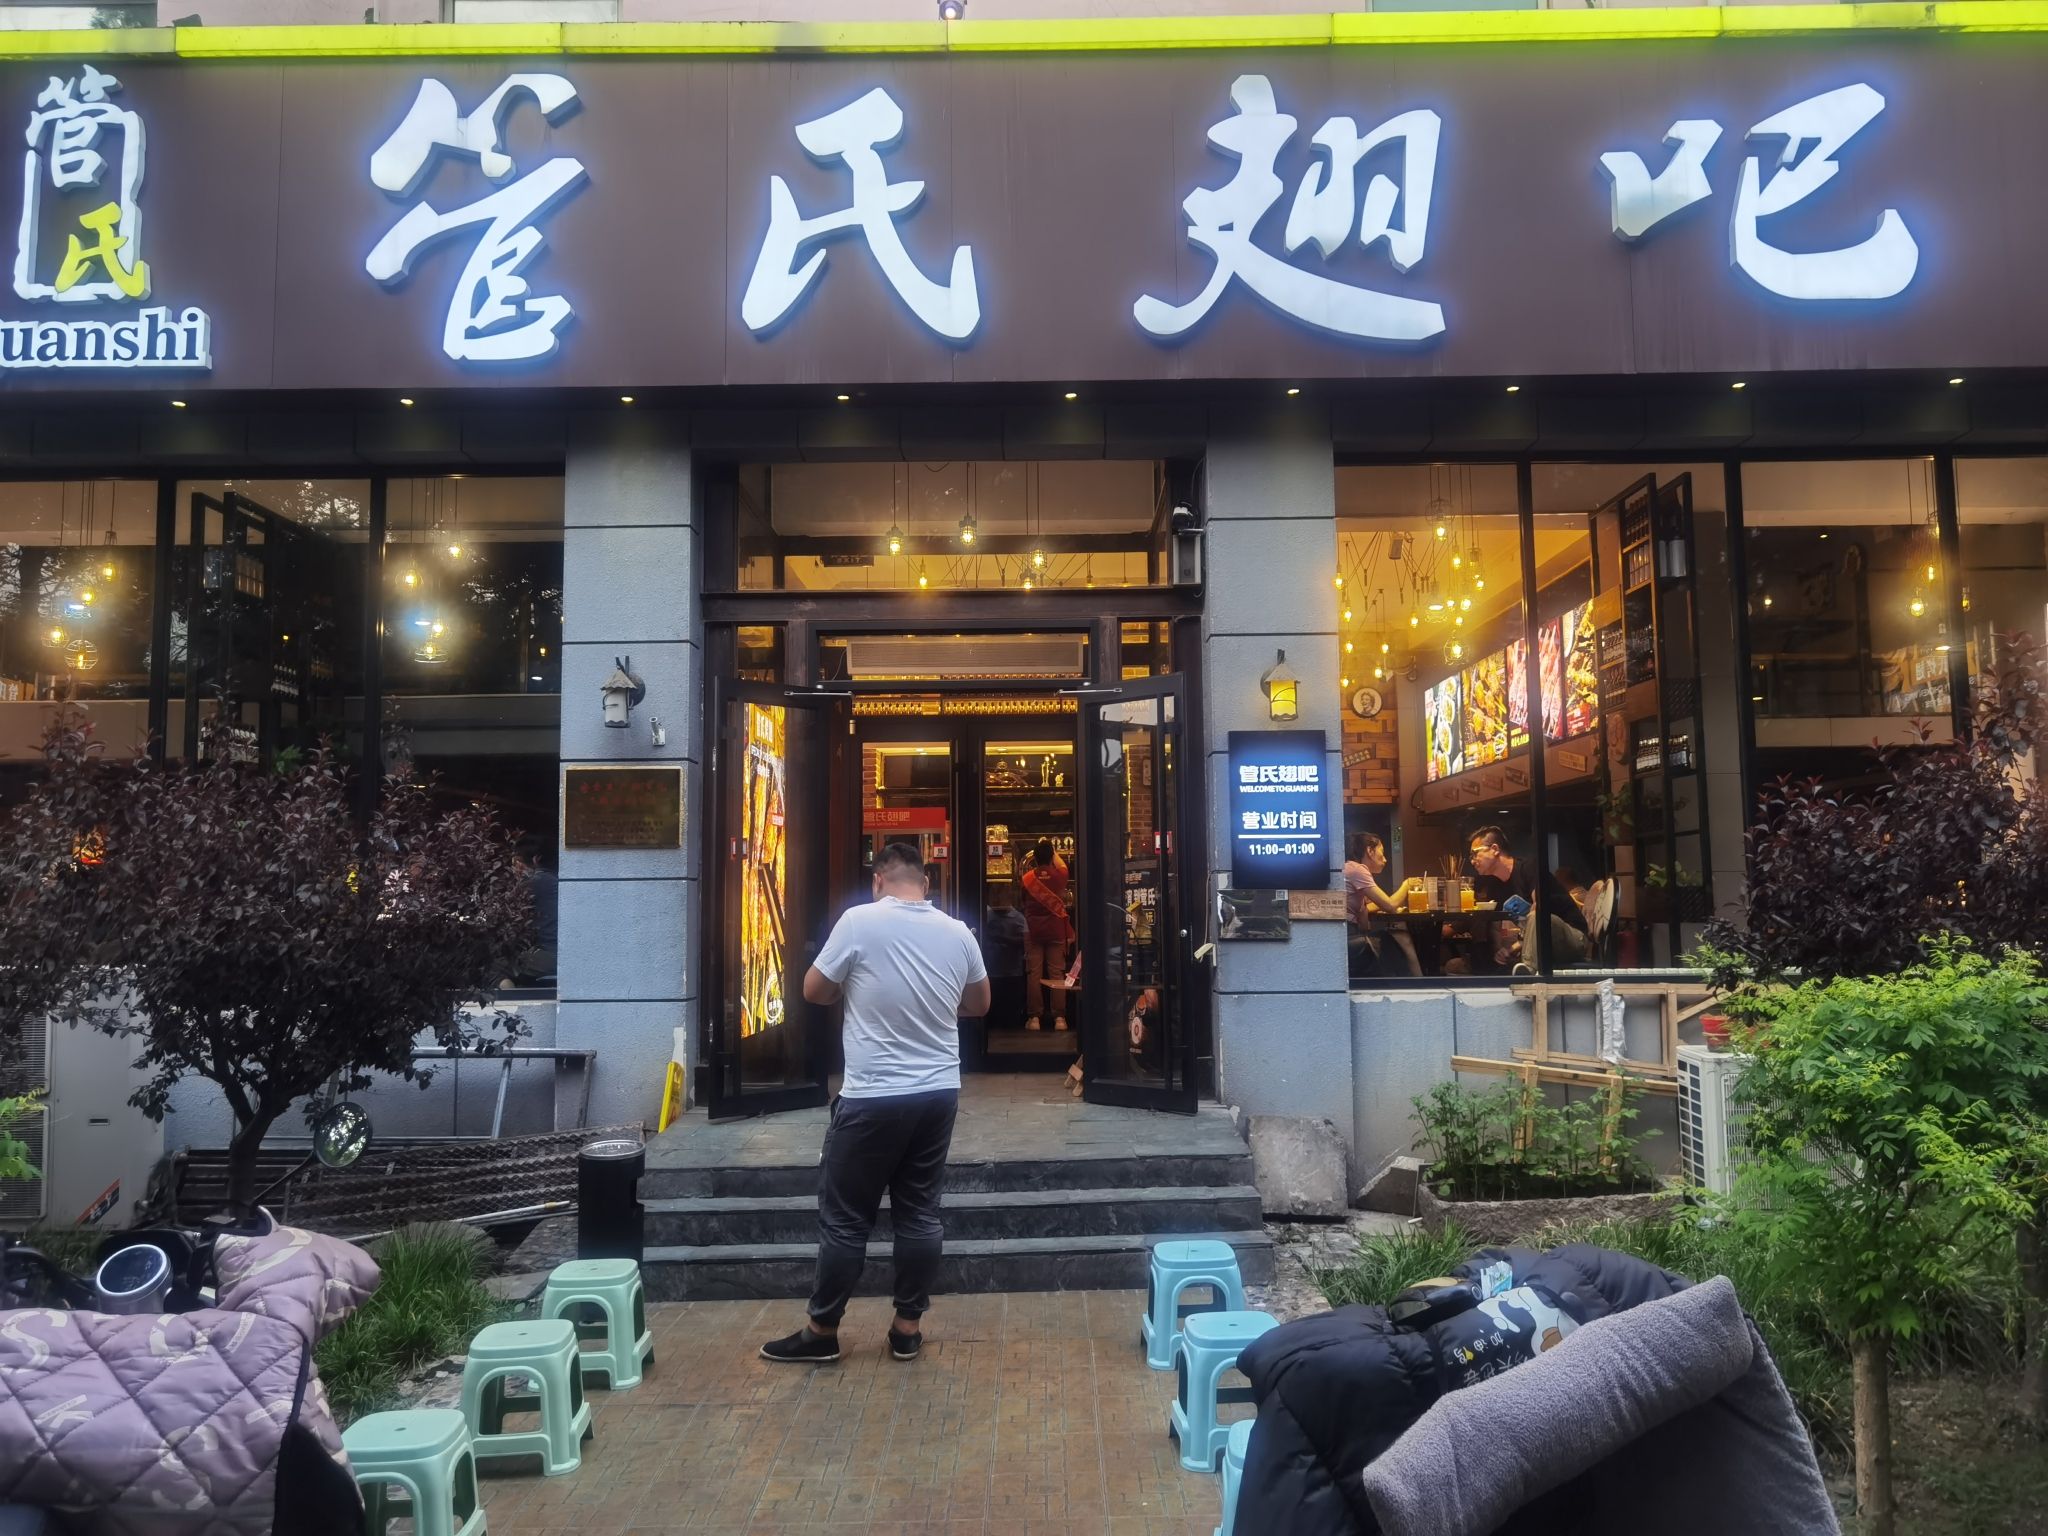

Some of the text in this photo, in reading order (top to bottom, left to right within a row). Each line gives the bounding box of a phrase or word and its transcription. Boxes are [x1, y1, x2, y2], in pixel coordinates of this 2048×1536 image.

[365, 72, 1920, 363] 管氏翅吧
[1239, 765, 1319, 782] 管氏翅吧
[1242, 811, 1317, 829] 营业时间
[1249, 843, 1316, 856] 11:00-01:00
